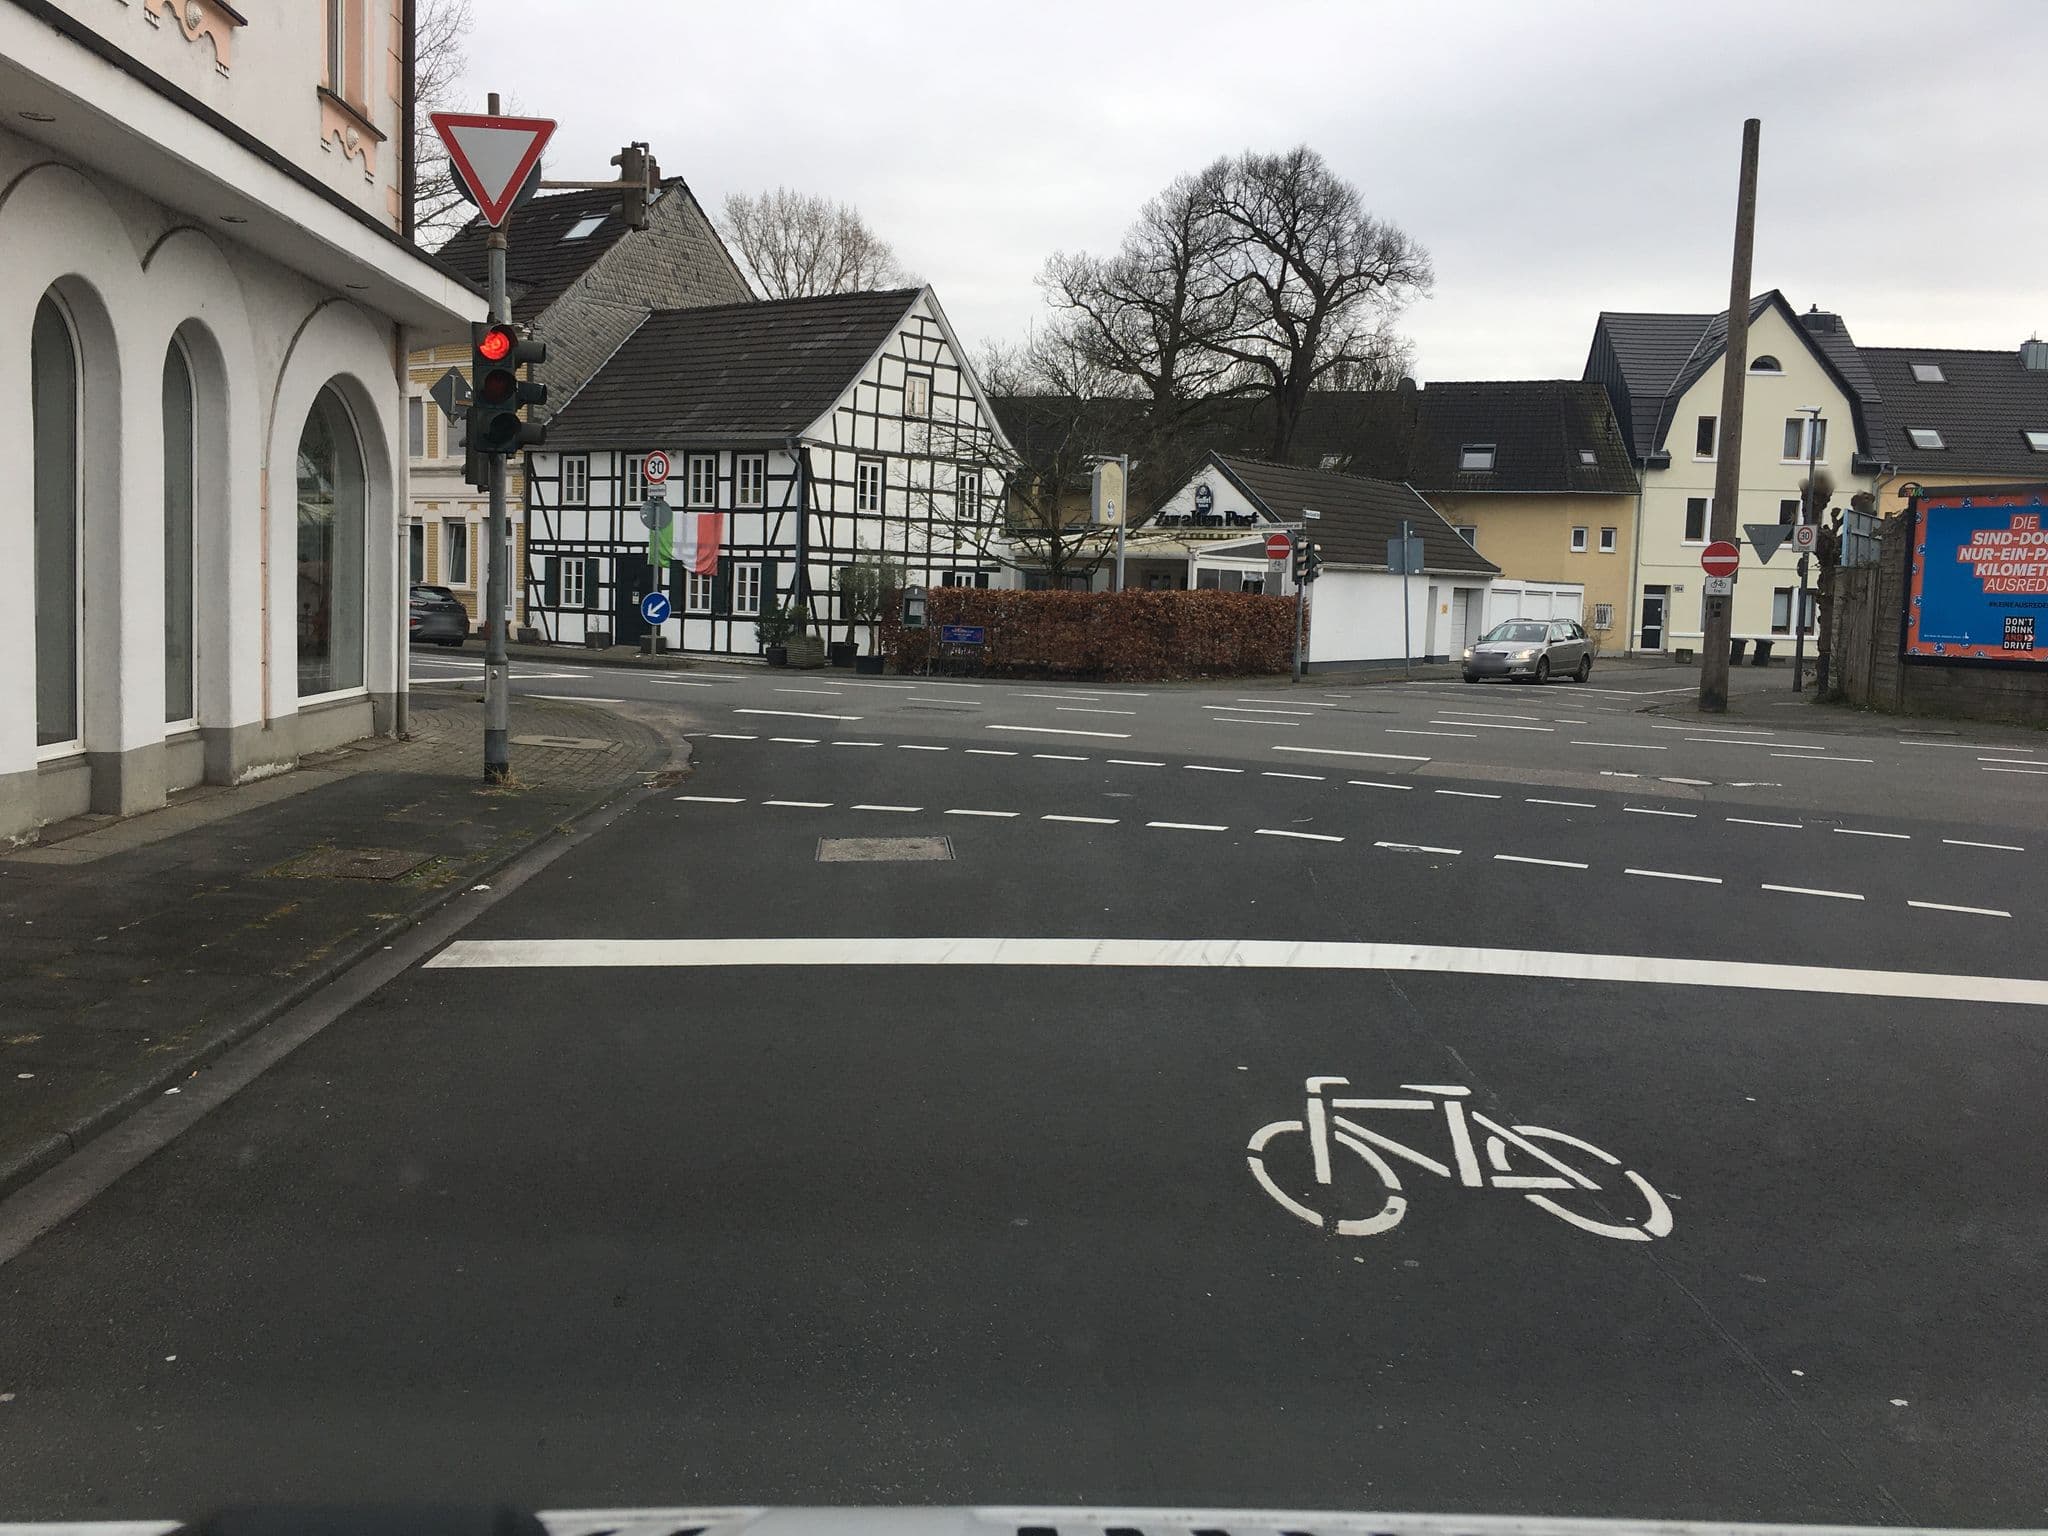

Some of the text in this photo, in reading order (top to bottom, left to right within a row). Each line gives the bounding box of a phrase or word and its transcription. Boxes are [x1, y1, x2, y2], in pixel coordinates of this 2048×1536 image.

[649, 460, 665, 475] 30
[1153, 510, 1260, 527] Zur alten Post
[2013, 516, 2038, 530] DIE
[1800, 531, 1810, 541] 30
[1976, 563, 2048, 577] KILOMET
[1985, 578, 2048, 592] AUSRED
[2005, 617, 2034, 626] DON'T
[2005, 625, 2033, 634] DRINK
[2003, 641, 2033, 650] DRIVE
